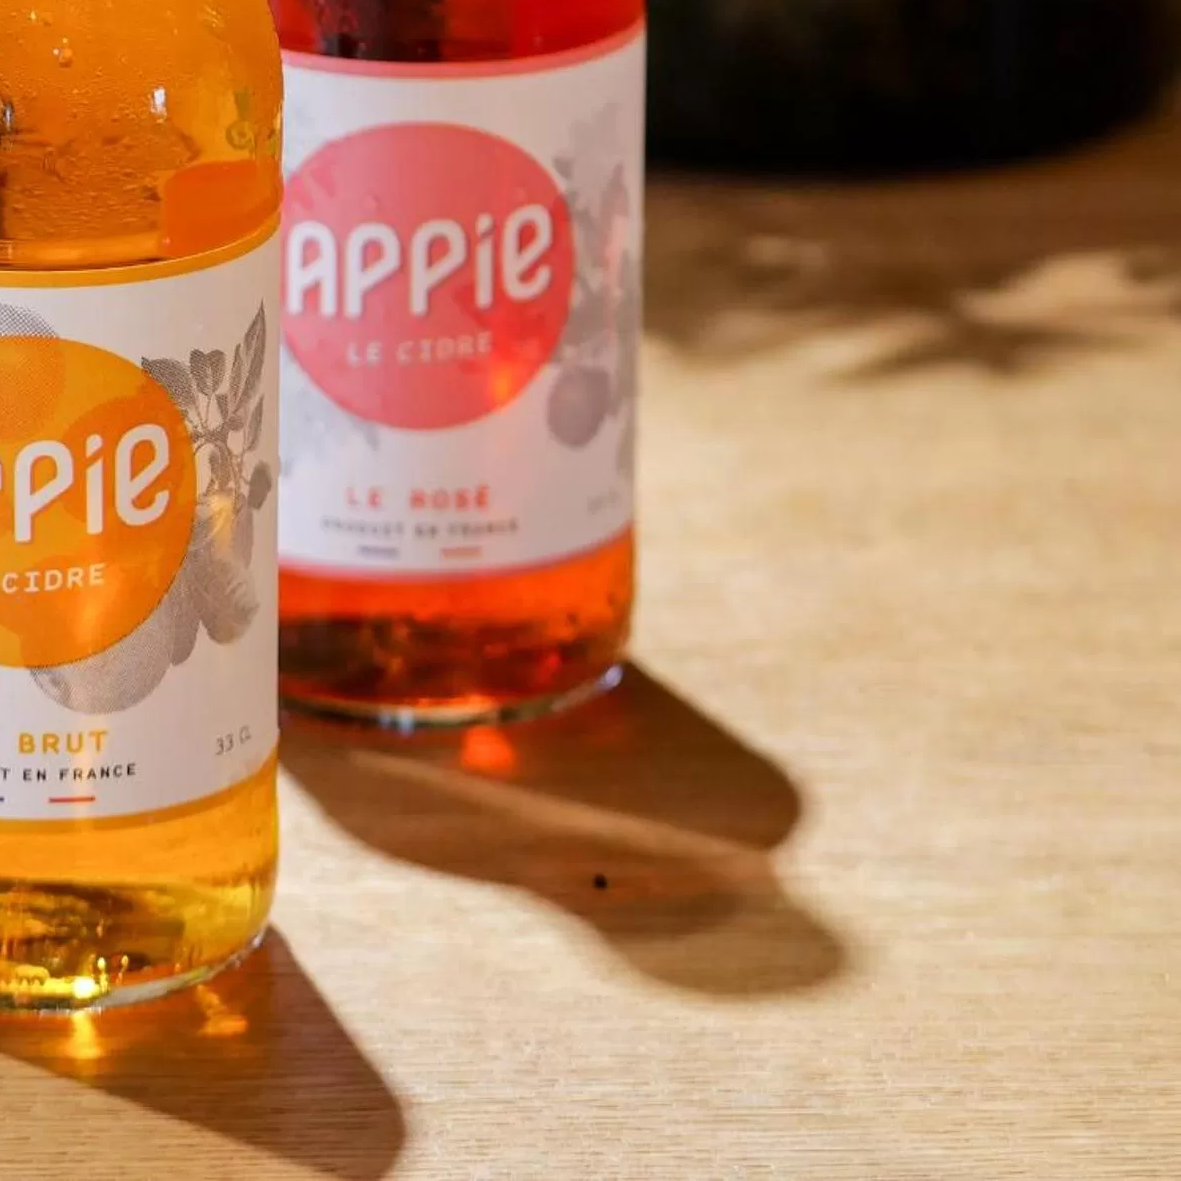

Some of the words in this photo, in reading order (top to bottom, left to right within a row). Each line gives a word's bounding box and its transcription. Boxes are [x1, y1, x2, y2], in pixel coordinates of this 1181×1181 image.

[347, 340, 381, 368] LE
[396, 330, 493, 365] CIDRE
[2, 563, 106, 594] CIDRE
[18, 728, 108, 754] BRUT
[23, 769, 47, 782] EN
[59, 762, 137, 781] FRANCE
